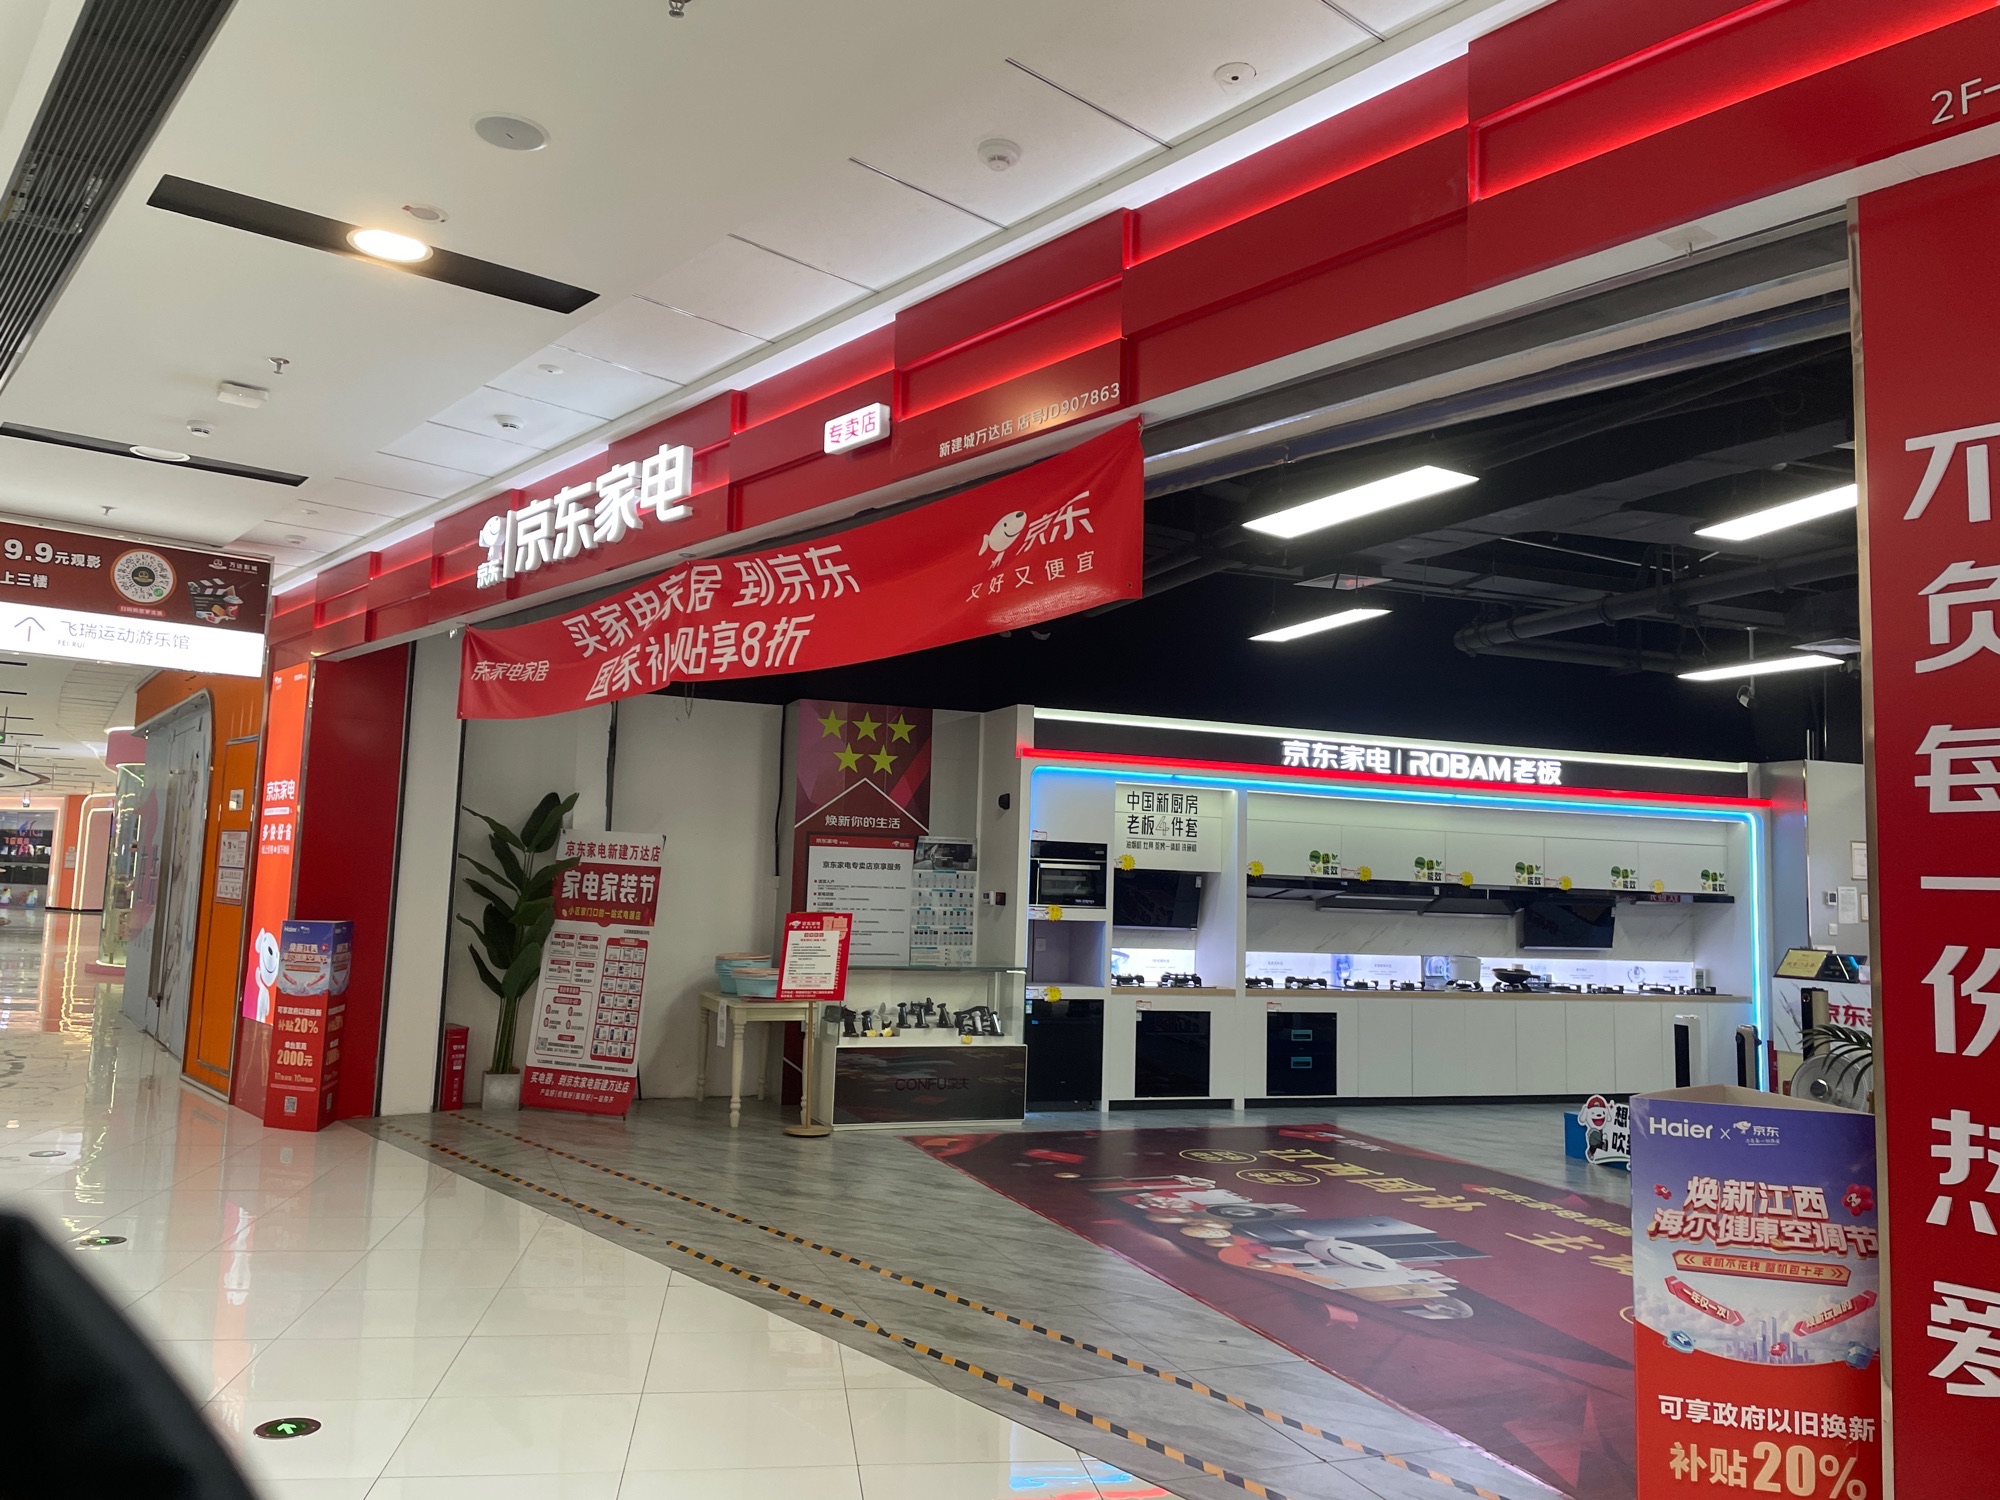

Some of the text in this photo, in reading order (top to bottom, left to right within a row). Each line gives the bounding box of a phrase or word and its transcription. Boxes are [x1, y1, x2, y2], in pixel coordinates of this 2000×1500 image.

[829, 411, 876, 443] 专卖店
[938, 382, 1120, 458] 新建城万达店 店号JD907863
[514, 443, 693, 572] 京东家电
[1016, 490, 1094, 556] 京东
[4, 538, 101, 569] 9.9元观影
[0, 571, 48, 589] 上三楼
[476, 559, 503, 588] 京东
[966, 550, 1094, 602] 又好又便宜
[562, 544, 860, 658] 买家电家居 到京东
[60, 620, 190, 650] 飞瑞运动游乐馆
[585, 613, 816, 701] 国家补贴享8折
[1280, 740, 1391, 774] 京东家电
[266, 779, 296, 801] 京东家电
[1127, 790, 1198, 815] 中国新厨房
[824, 814, 901, 829] 焕新你的生活
[1127, 814, 1198, 838] 老板4件套
[565, 840, 661, 862] 京东家电新建万达店
[822, 861, 902, 871] 京东家电专卖店京享服务
[561, 869, 656, 905] 家电家装节
[278, 1017, 319, 1034] 补贴20%
[276, 1049, 313, 1067] 2000元
[1614, 1106, 1630, 1128] 想
[1649, 1116, 1714, 1139] Haier
[1752, 1125, 1780, 1138] 京东
[1612, 1132, 1630, 1156] 吹
[1258, 1148, 1488, 1213] 江西国补
[1683, 1175, 1829, 1220] 焕新江西
[1652, 1207, 1878, 1255] 海尔健康空调节
[1702, 1256, 1825, 1277] 装机不花钱 整机包十年
[1657, 1394, 1877, 1443] 可享政府以旧换新
[1669, 1440, 1868, 1500] 补贴20%
